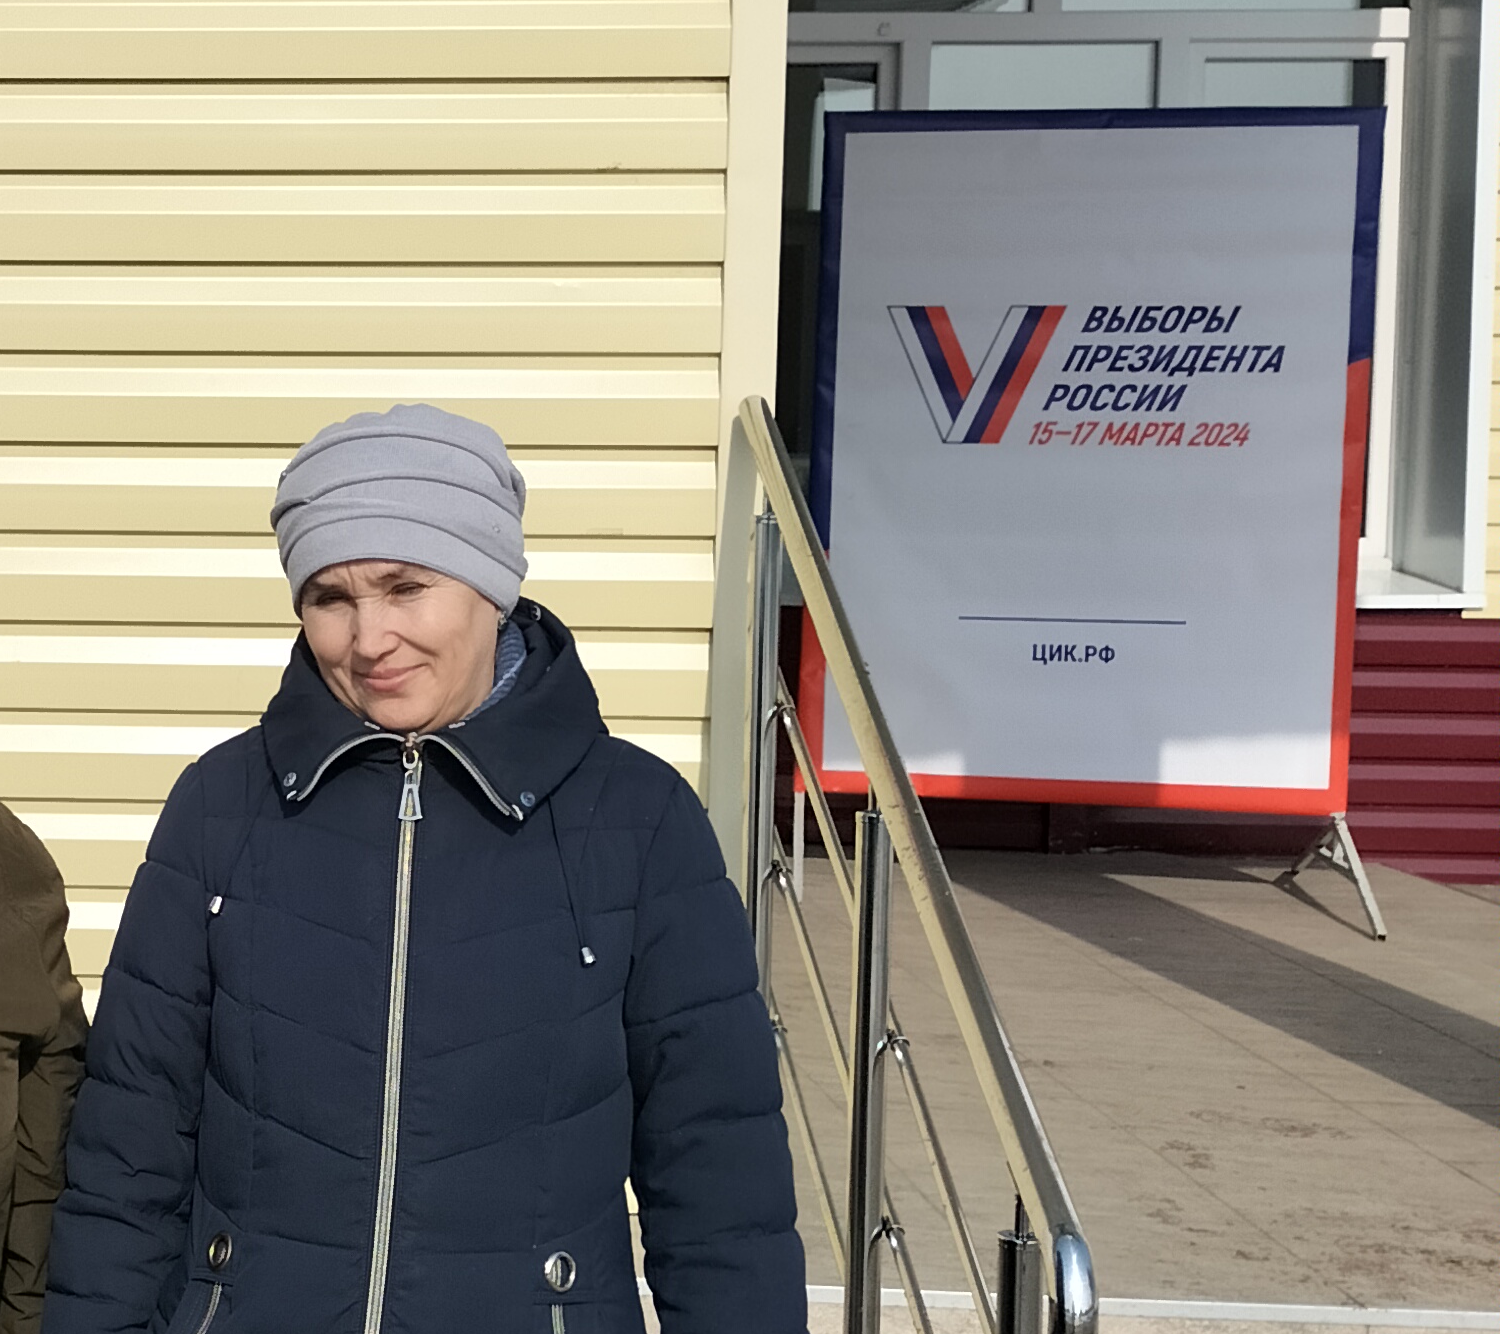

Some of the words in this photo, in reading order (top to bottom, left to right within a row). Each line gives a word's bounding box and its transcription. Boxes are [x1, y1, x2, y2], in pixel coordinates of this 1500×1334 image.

[1081, 305, 1242, 334] ВЫБОРЫ
[1061, 344, 1286, 377] ПРЕЗИДЕНТА
[1042, 383, 1188, 412] РОССИИ
[1099, 422, 1186, 447] МАРТА
[1187, 422, 1250, 448] 2024
[1032, 643, 1116, 666] ЦИК.РФ
